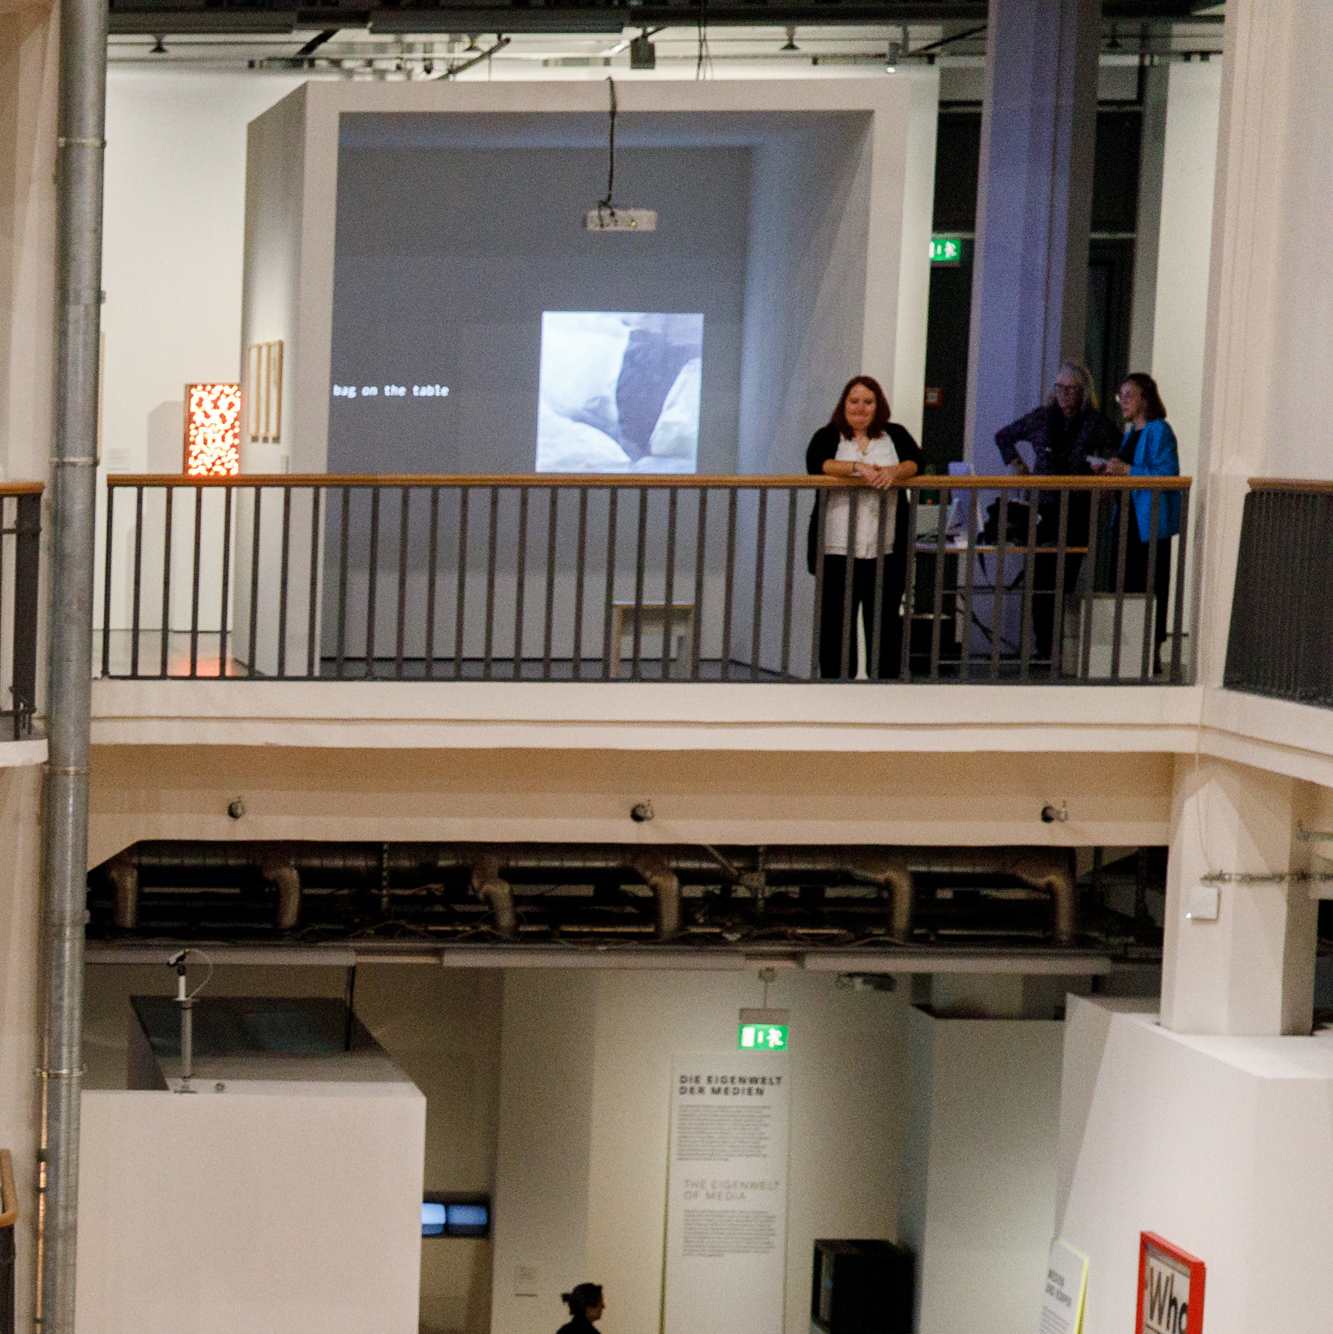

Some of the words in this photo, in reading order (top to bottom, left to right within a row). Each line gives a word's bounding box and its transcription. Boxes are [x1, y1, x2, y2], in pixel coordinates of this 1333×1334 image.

[332, 384, 357, 399] bag
[361, 386, 379, 397] on
[383, 384, 407, 397] the
[412, 384, 450, 397] table
[680, 1074, 701, 1085] DIE
[706, 1074, 782, 1086] EIGENWELT
[679, 1086, 705, 1096] DER
[710, 1086, 765, 1097] MEDIEN
